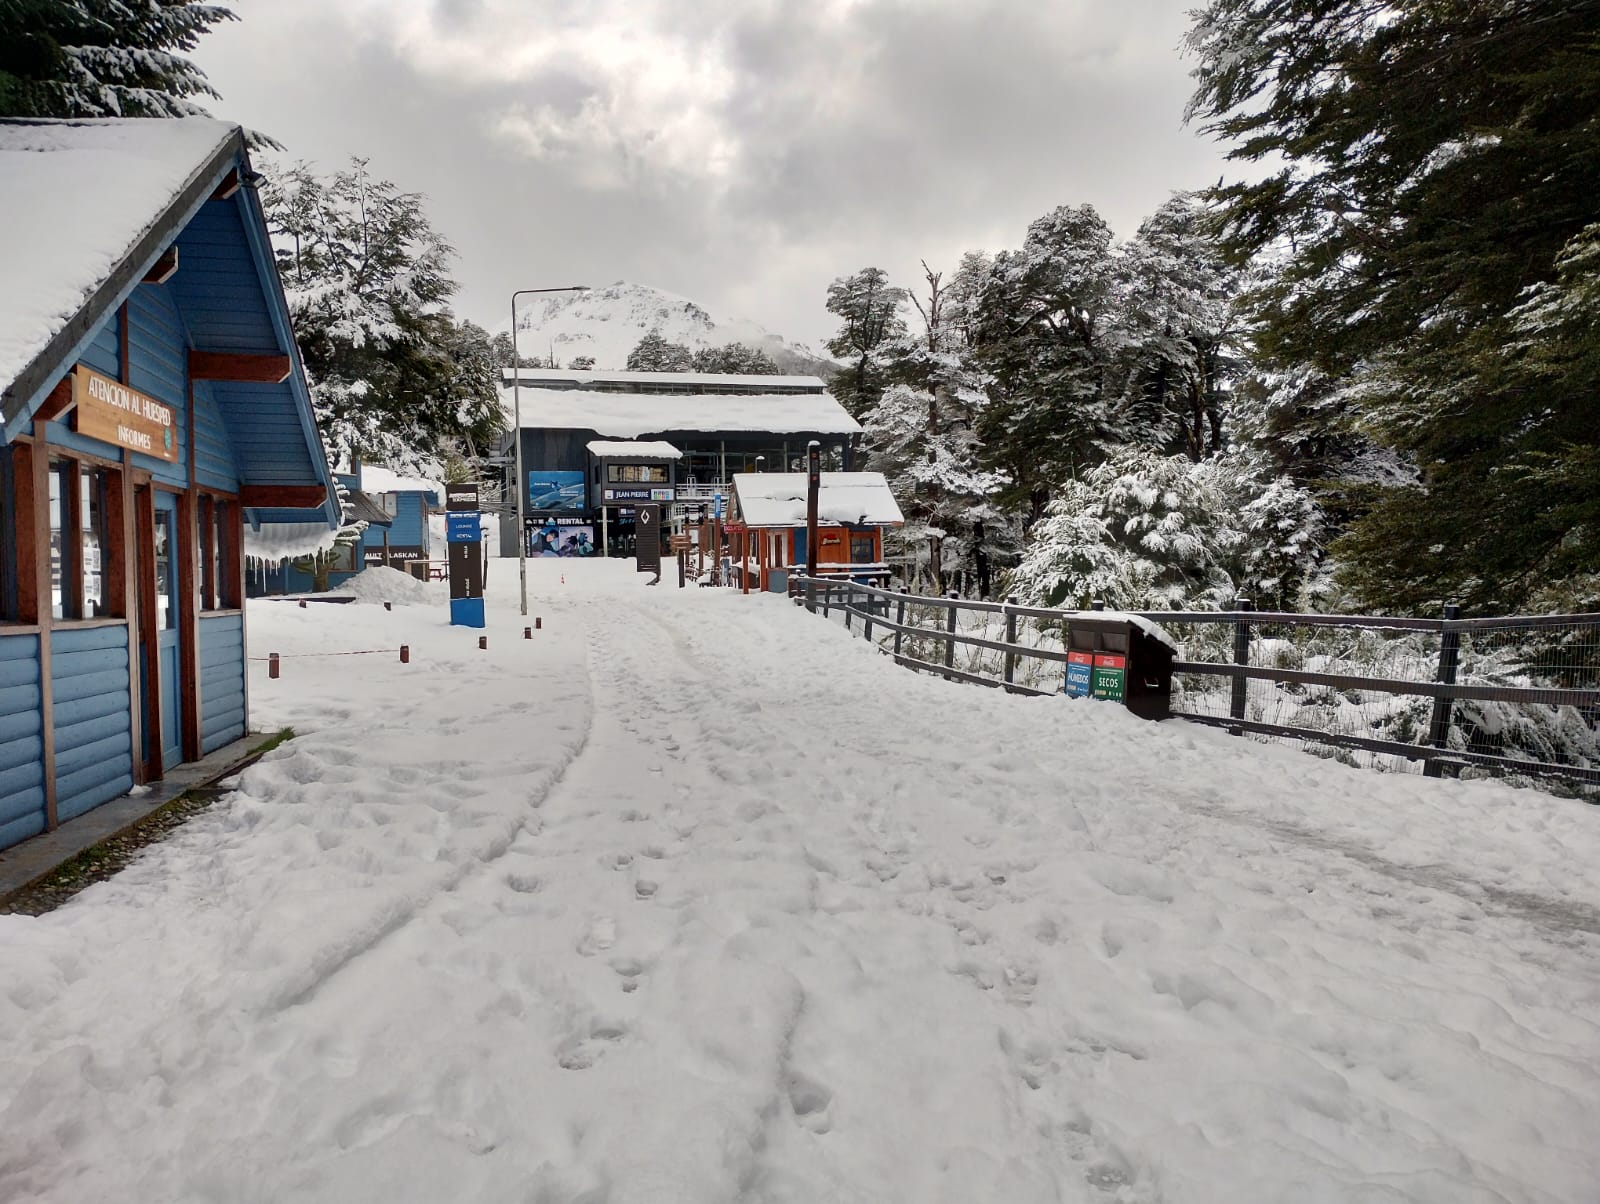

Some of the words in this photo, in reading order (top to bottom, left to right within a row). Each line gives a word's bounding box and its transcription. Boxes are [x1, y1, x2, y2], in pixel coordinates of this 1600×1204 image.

[88, 376, 130, 410] ATENCION
[131, 394, 141, 415] AL
[142, 398, 171, 427] HUESPED
[118, 425, 151, 449] INFORMES
[615, 490, 630, 498] JEAN
[630, 490, 649, 498] PIERRE
[556, 517, 585, 525] RENTAL
[1098, 677, 1119, 688] SECOS
